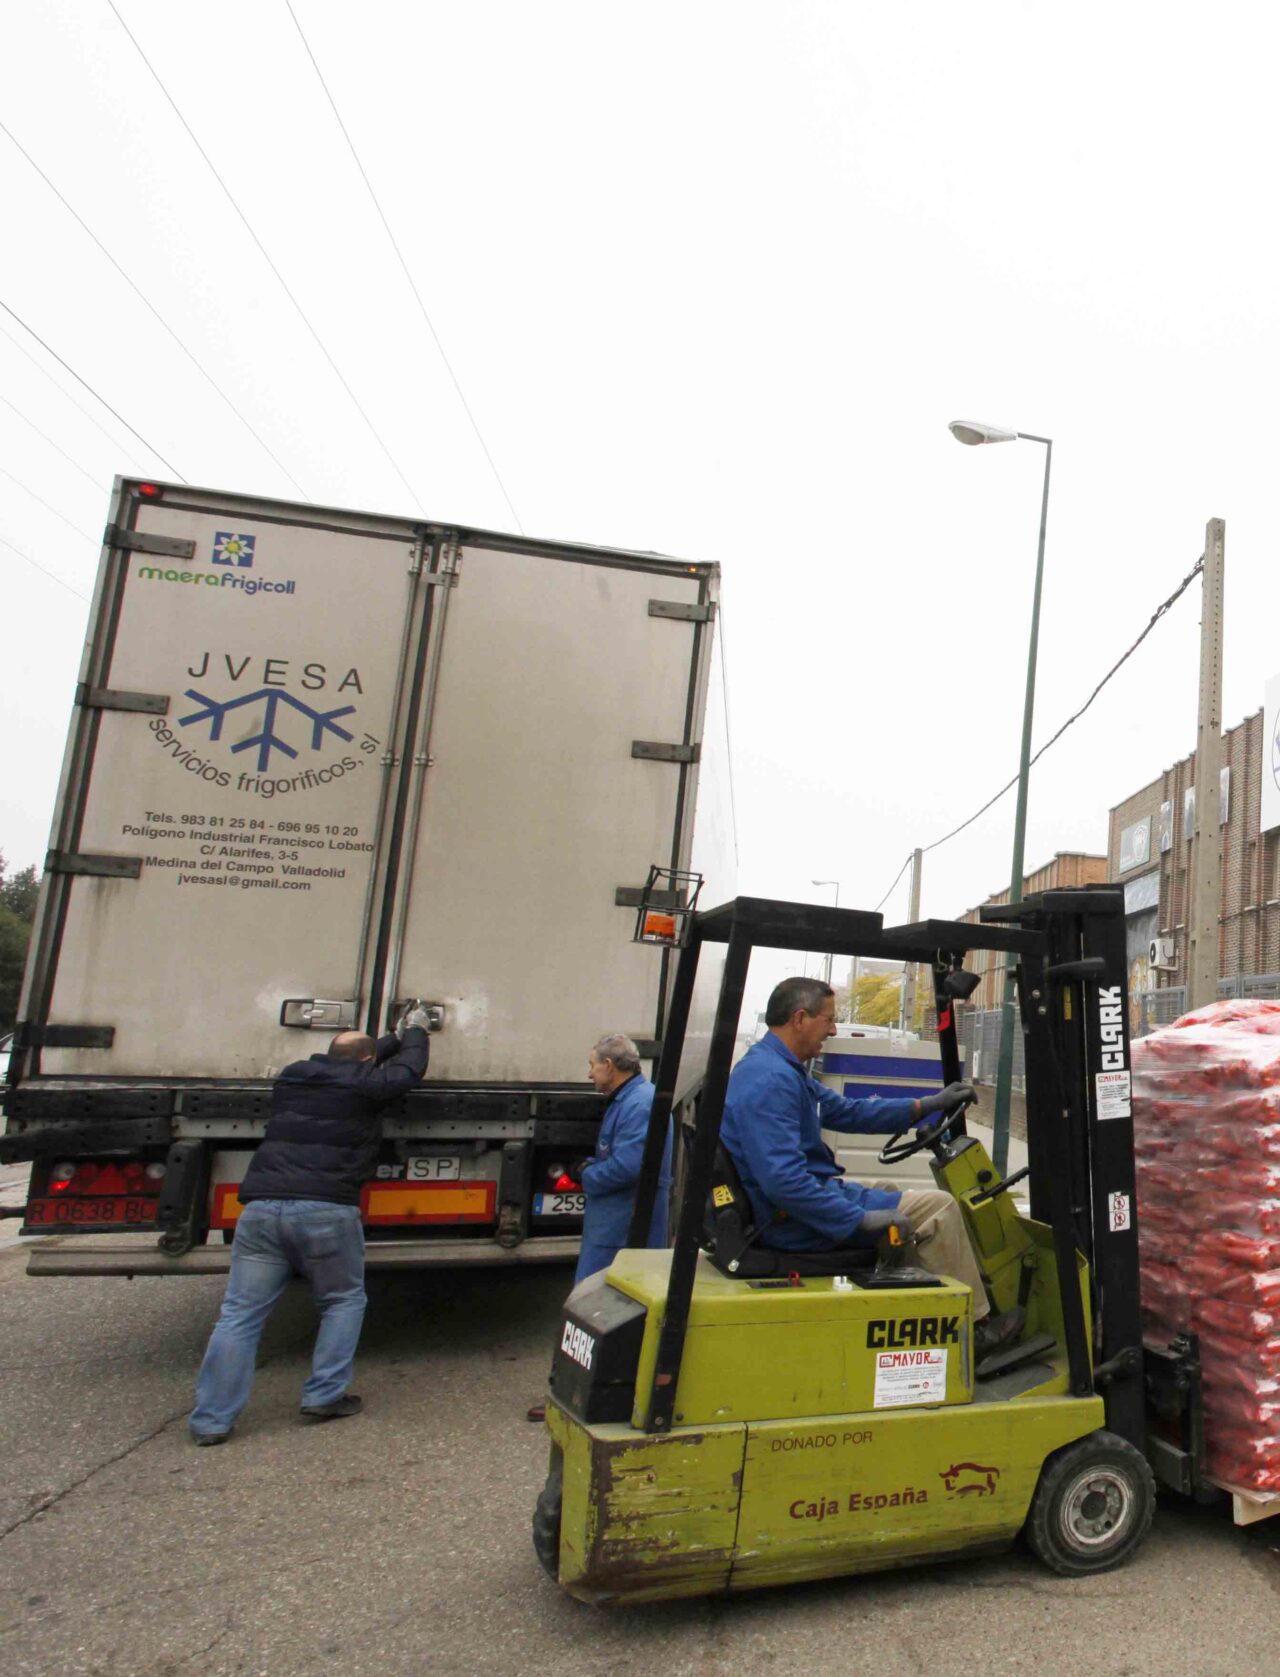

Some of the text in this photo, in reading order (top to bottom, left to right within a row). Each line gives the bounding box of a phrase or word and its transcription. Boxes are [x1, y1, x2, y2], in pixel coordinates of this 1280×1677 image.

[188, 652, 364, 695] JVESA
[149, 718, 381, 798] servicios frigorificos, sl
[145, 811, 177, 824] Tels.
[181, 814, 205, 826] 983
[209, 816, 224, 827] 81
[229, 818, 245, 828] 25
[249, 820, 265, 830] 84
[277, 821, 301, 832] 696
[304, 823, 320, 834] 95
[325, 825, 339, 835] 10
[343, 826, 358, 836] 20
[122, 825, 375, 852] Polígono Industrial Francisco Lobato
[200, 844, 216, 855] C/
[278, 850, 298, 861] 3-5
[145, 856, 345, 878] Medina del Campo Valladolid
[177, 873, 311, 890] jvesasl@gmail.com
[1099, 985, 1125, 1071] CLARK
[376, 1163, 404, 1178] er
[413, 1159, 453, 1178] SP
[31, 1201, 157, 1221] R 0638 BC
[552, 1194, 588, 1212] 259
[866, 1316, 960, 1348] CLARK
[561, 1320, 595, 1370] CLARK
[894, 1351, 931, 1367] MAYOR
[771, 1431, 873, 1452] DONADO POR
[789, 1487, 928, 1522] Caja España
